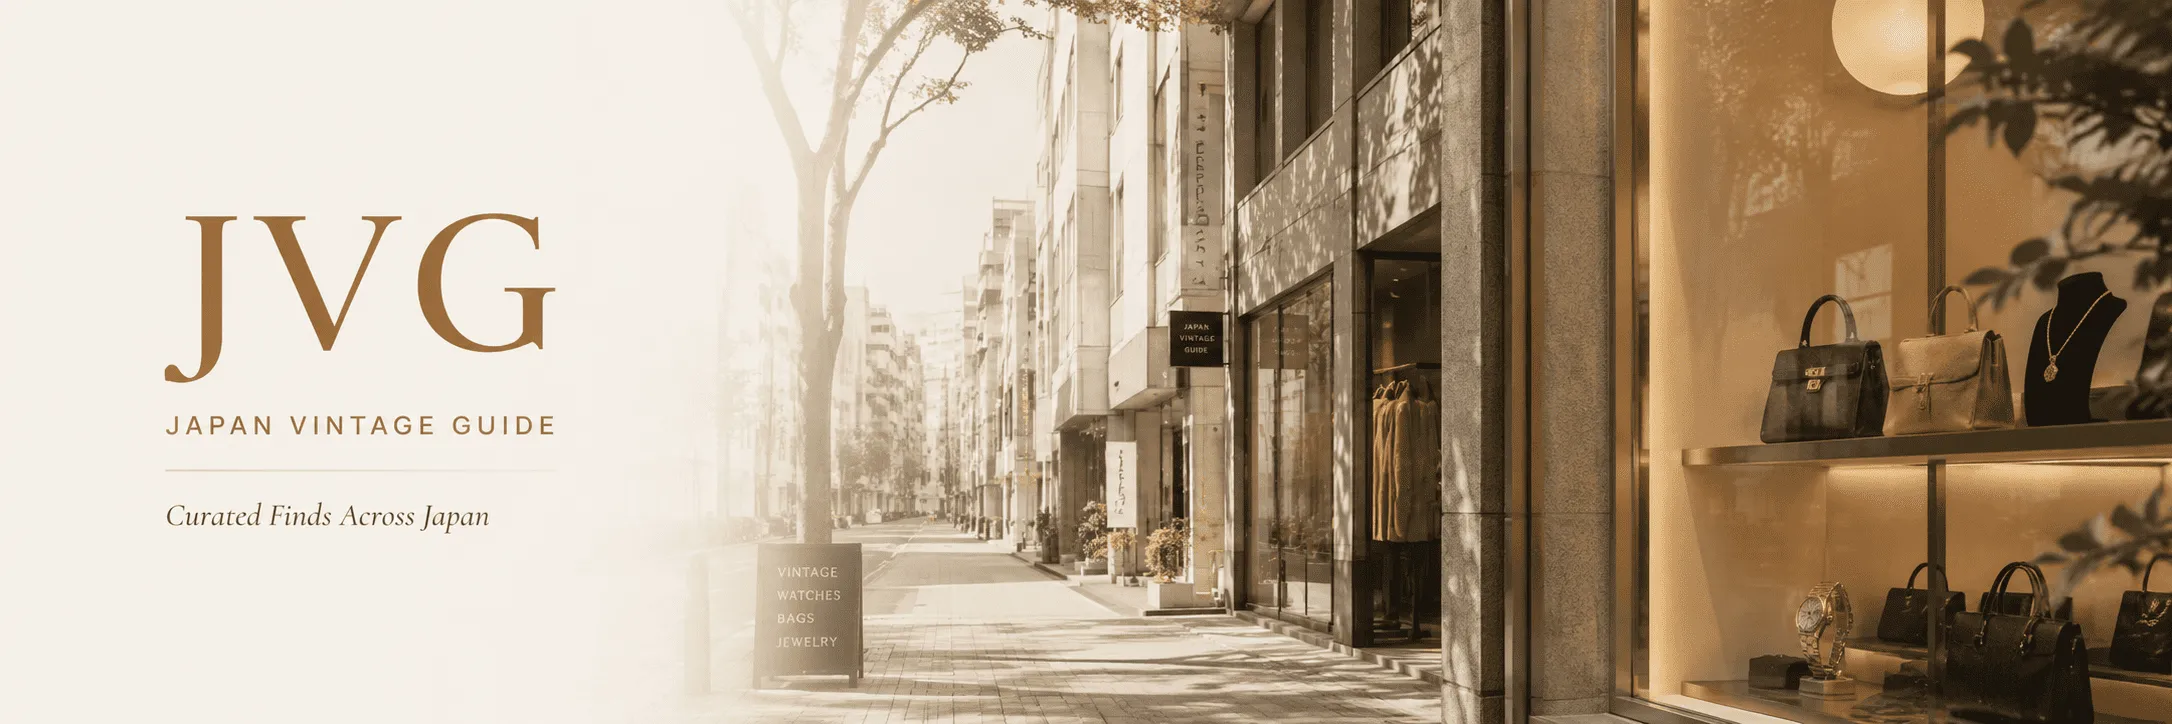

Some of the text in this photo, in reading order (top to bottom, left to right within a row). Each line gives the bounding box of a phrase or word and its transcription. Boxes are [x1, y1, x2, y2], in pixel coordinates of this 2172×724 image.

[1183, 323, 1210, 331] JAPAN
[1179, 334, 1216, 343] VINTAGE
[1184, 346, 1209, 354] GUIDE
[777, 566, 839, 578] VINTAGE
[776, 589, 841, 601] WATCHES
[777, 612, 815, 624] BAGS
[775, 636, 838, 648] JEWELRY
